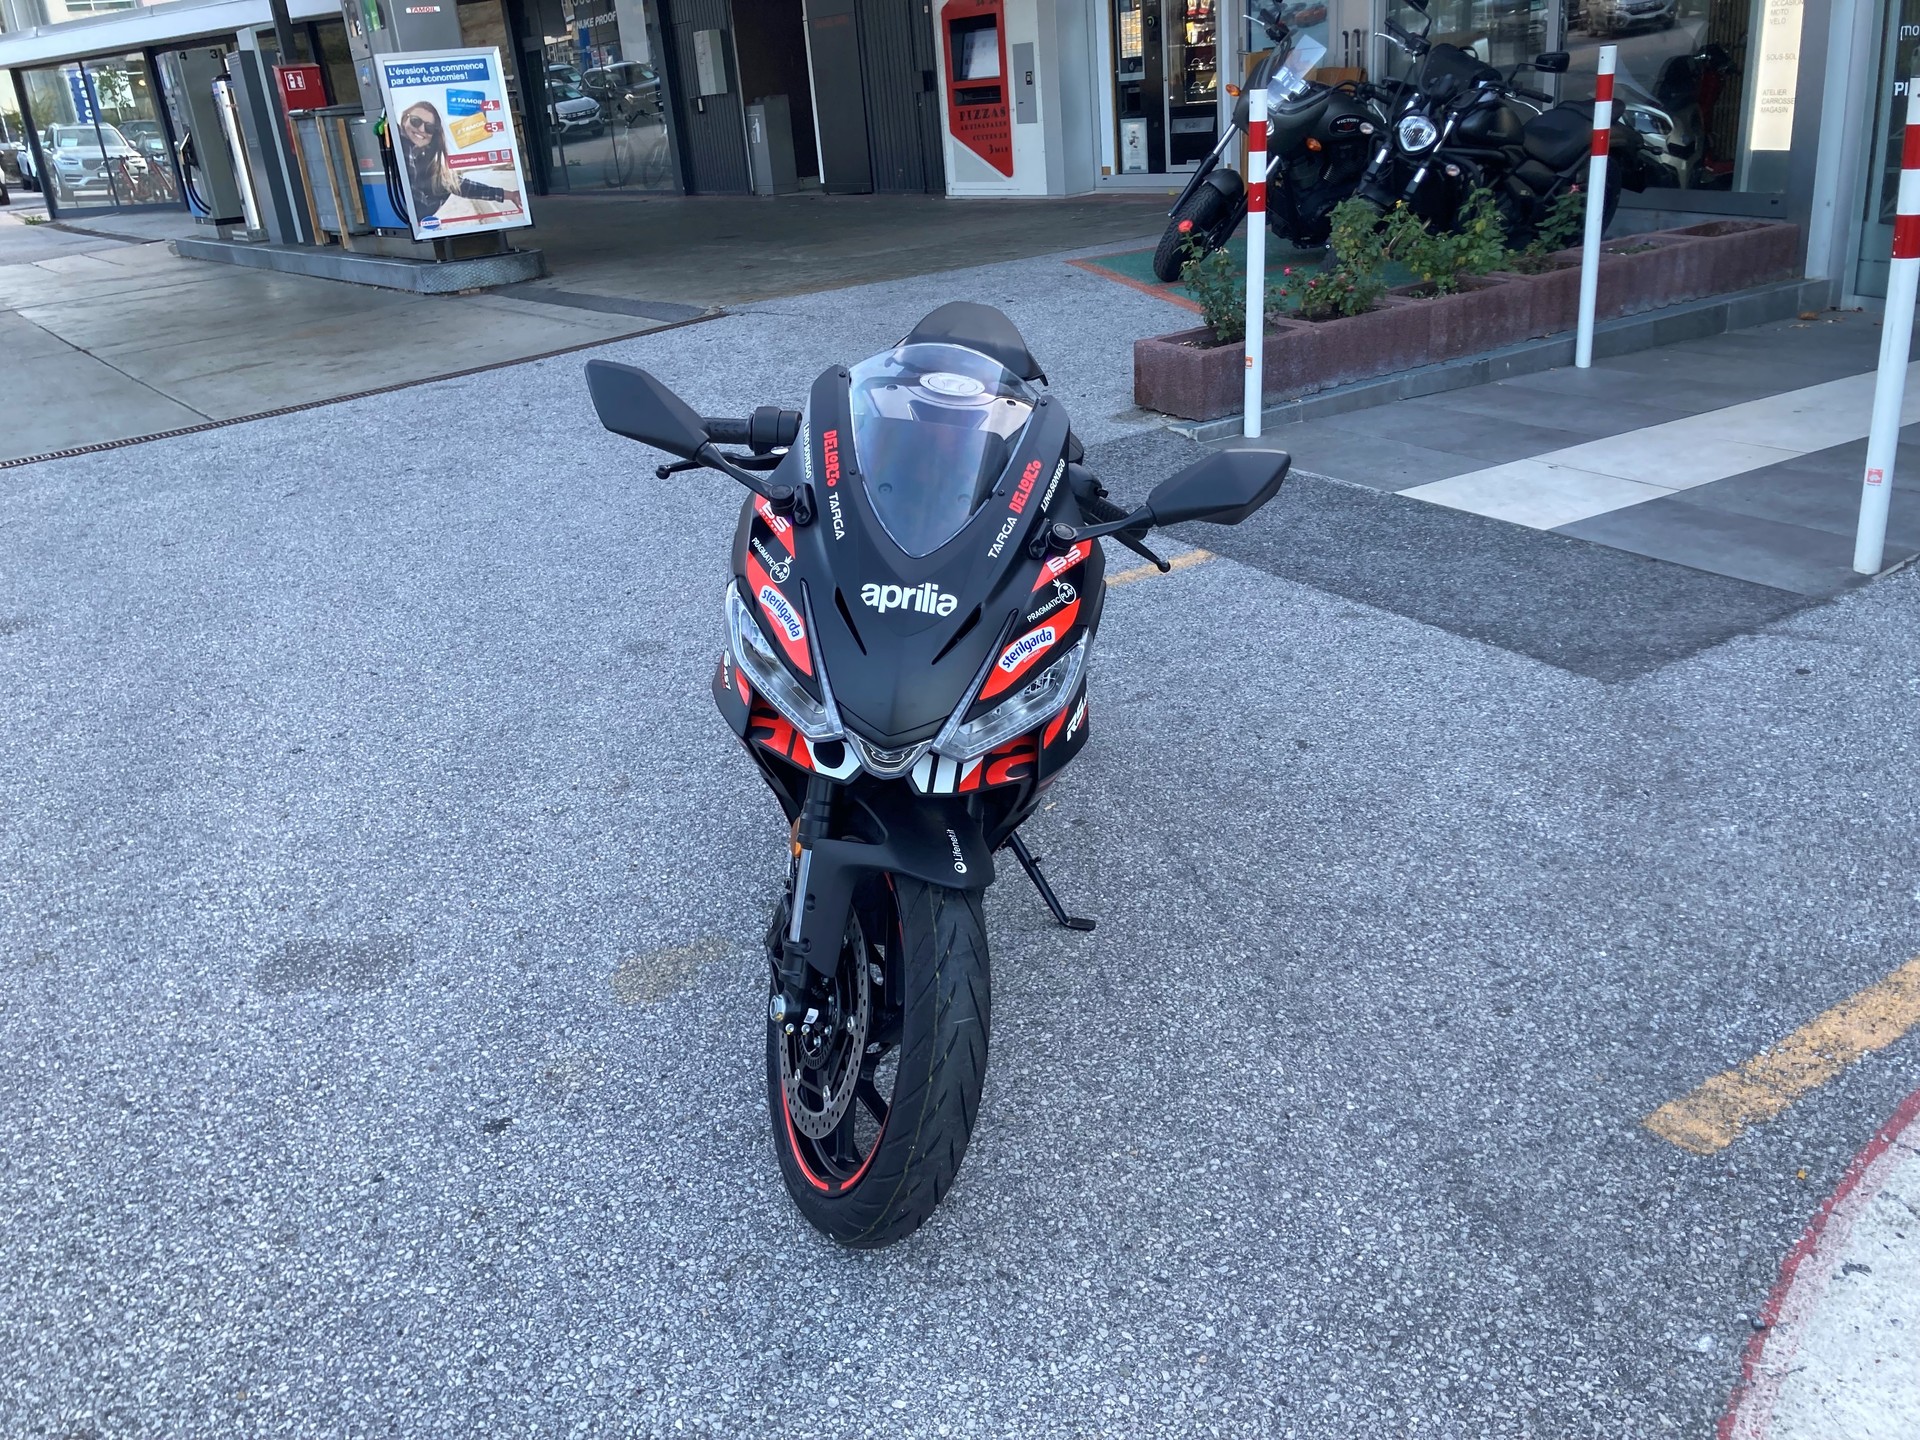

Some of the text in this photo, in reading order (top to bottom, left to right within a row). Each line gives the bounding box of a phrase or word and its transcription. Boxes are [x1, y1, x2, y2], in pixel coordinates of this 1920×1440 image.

[1770, 8, 1789, 16] MOTO
[356, 20, 362, 35] 2
[576, 11, 616, 29] NUKE PROOF
[179, 50, 218, 61] 4 3
[388, 62, 484, 77] L'évasion, ça commence
[391, 77, 404, 87] par
[406, 74, 421, 84] des
[1762, 88, 1787, 96] ATELIER
[959, 106, 1006, 121] PIZZAS
[1760, 106, 1788, 114] MAGASIN
[450, 157, 478, 165] Commander
[828, 491, 846, 541] TARGA
[987, 517, 1018, 559] TARGA
[751, 537, 776, 569] PRAGMATIC
[1046, 544, 1081, 573] BS
[774, 566, 787, 580] PLAY
[861, 582, 957, 616] aprilia
[1060, 588, 1074, 600] PLAY
[761, 589, 801, 638] sterilgarda
[1027, 597, 1061, 623] PRAGMATIC
[1002, 627, 1053, 668] sterilgarda
